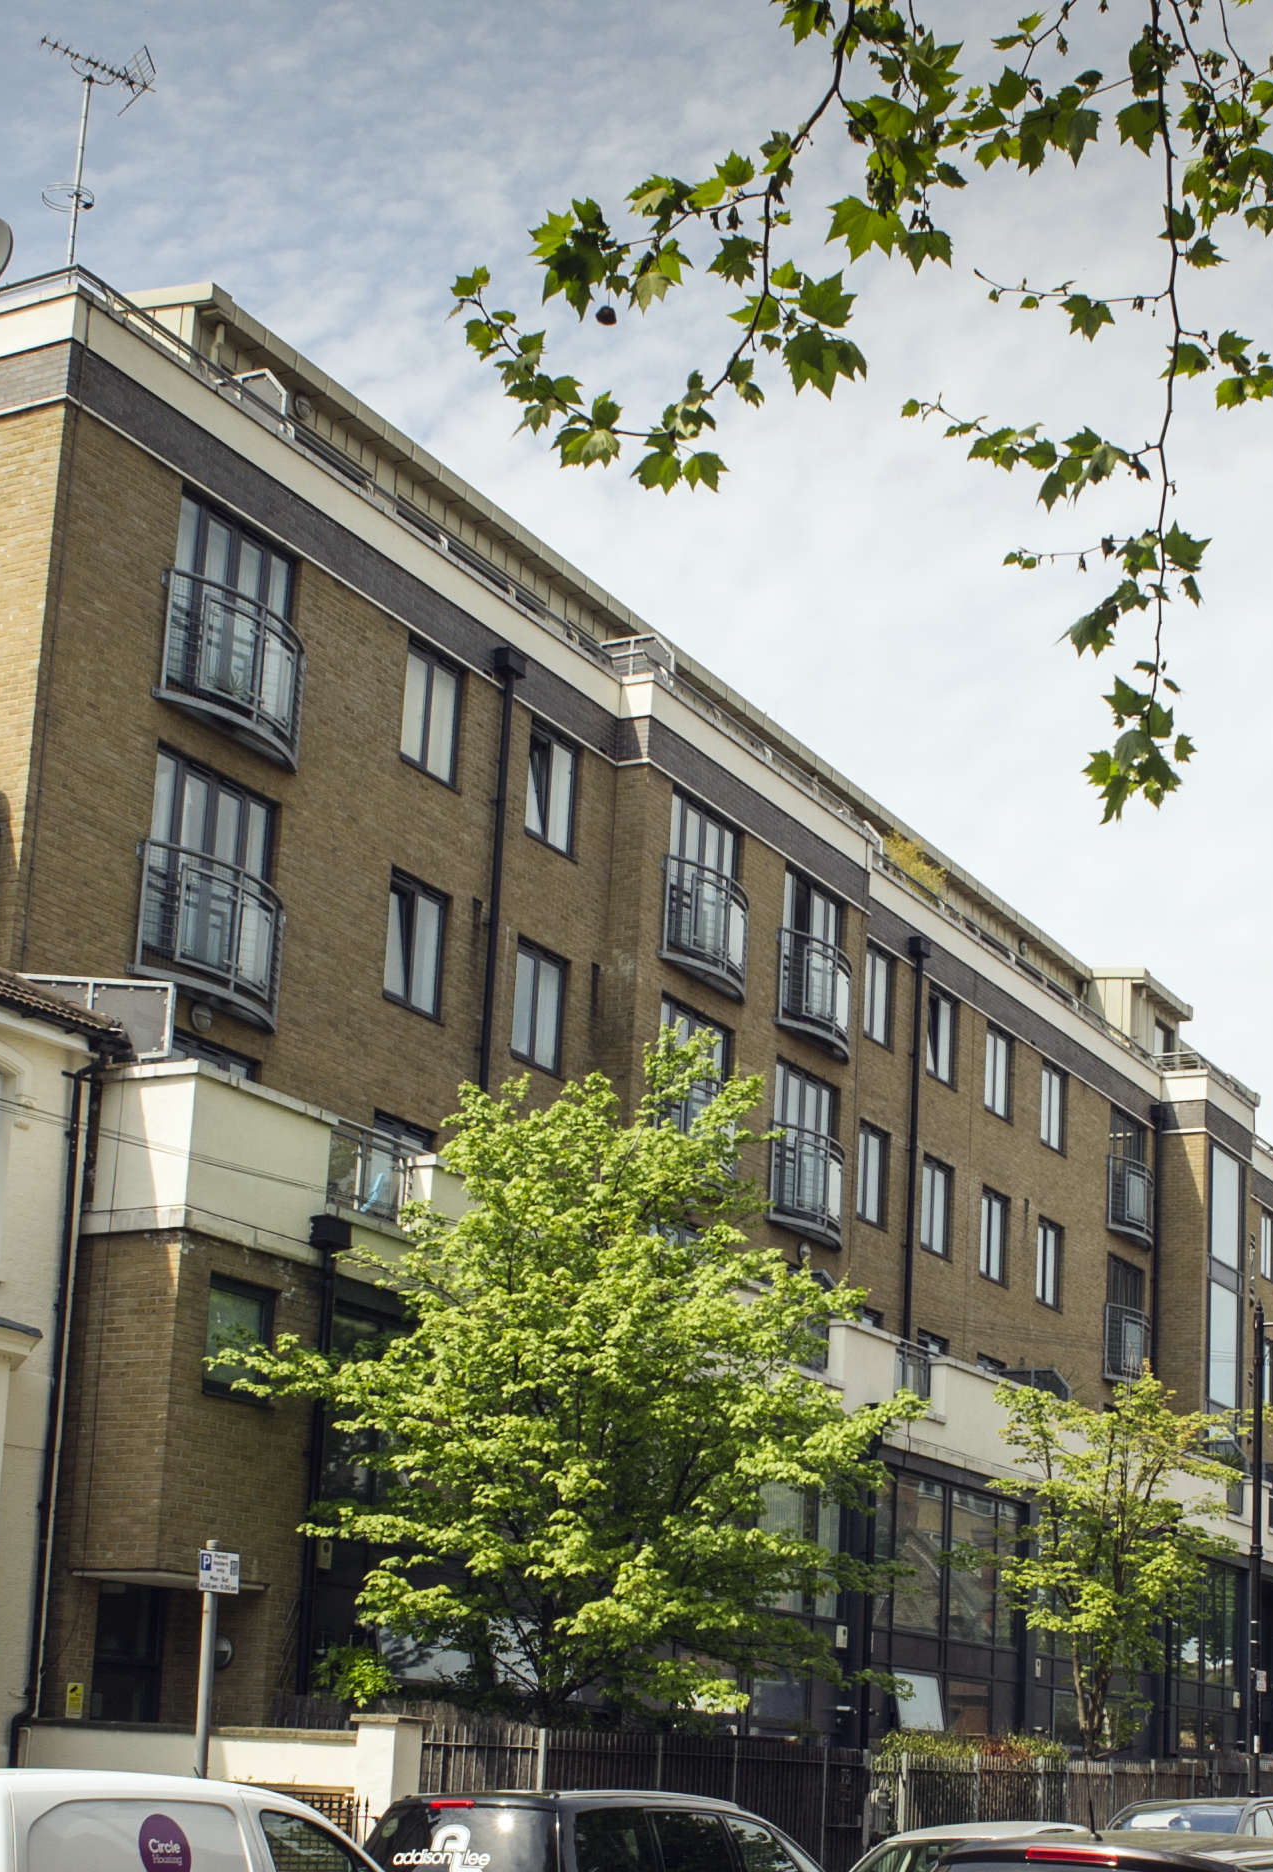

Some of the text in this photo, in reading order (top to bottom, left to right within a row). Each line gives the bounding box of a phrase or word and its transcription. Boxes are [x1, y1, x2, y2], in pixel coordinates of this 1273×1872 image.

[149, 1838, 181, 1854] Circle
[152, 1854, 183, 1866] Housing
[393, 1848, 491, 1866] addison lee
